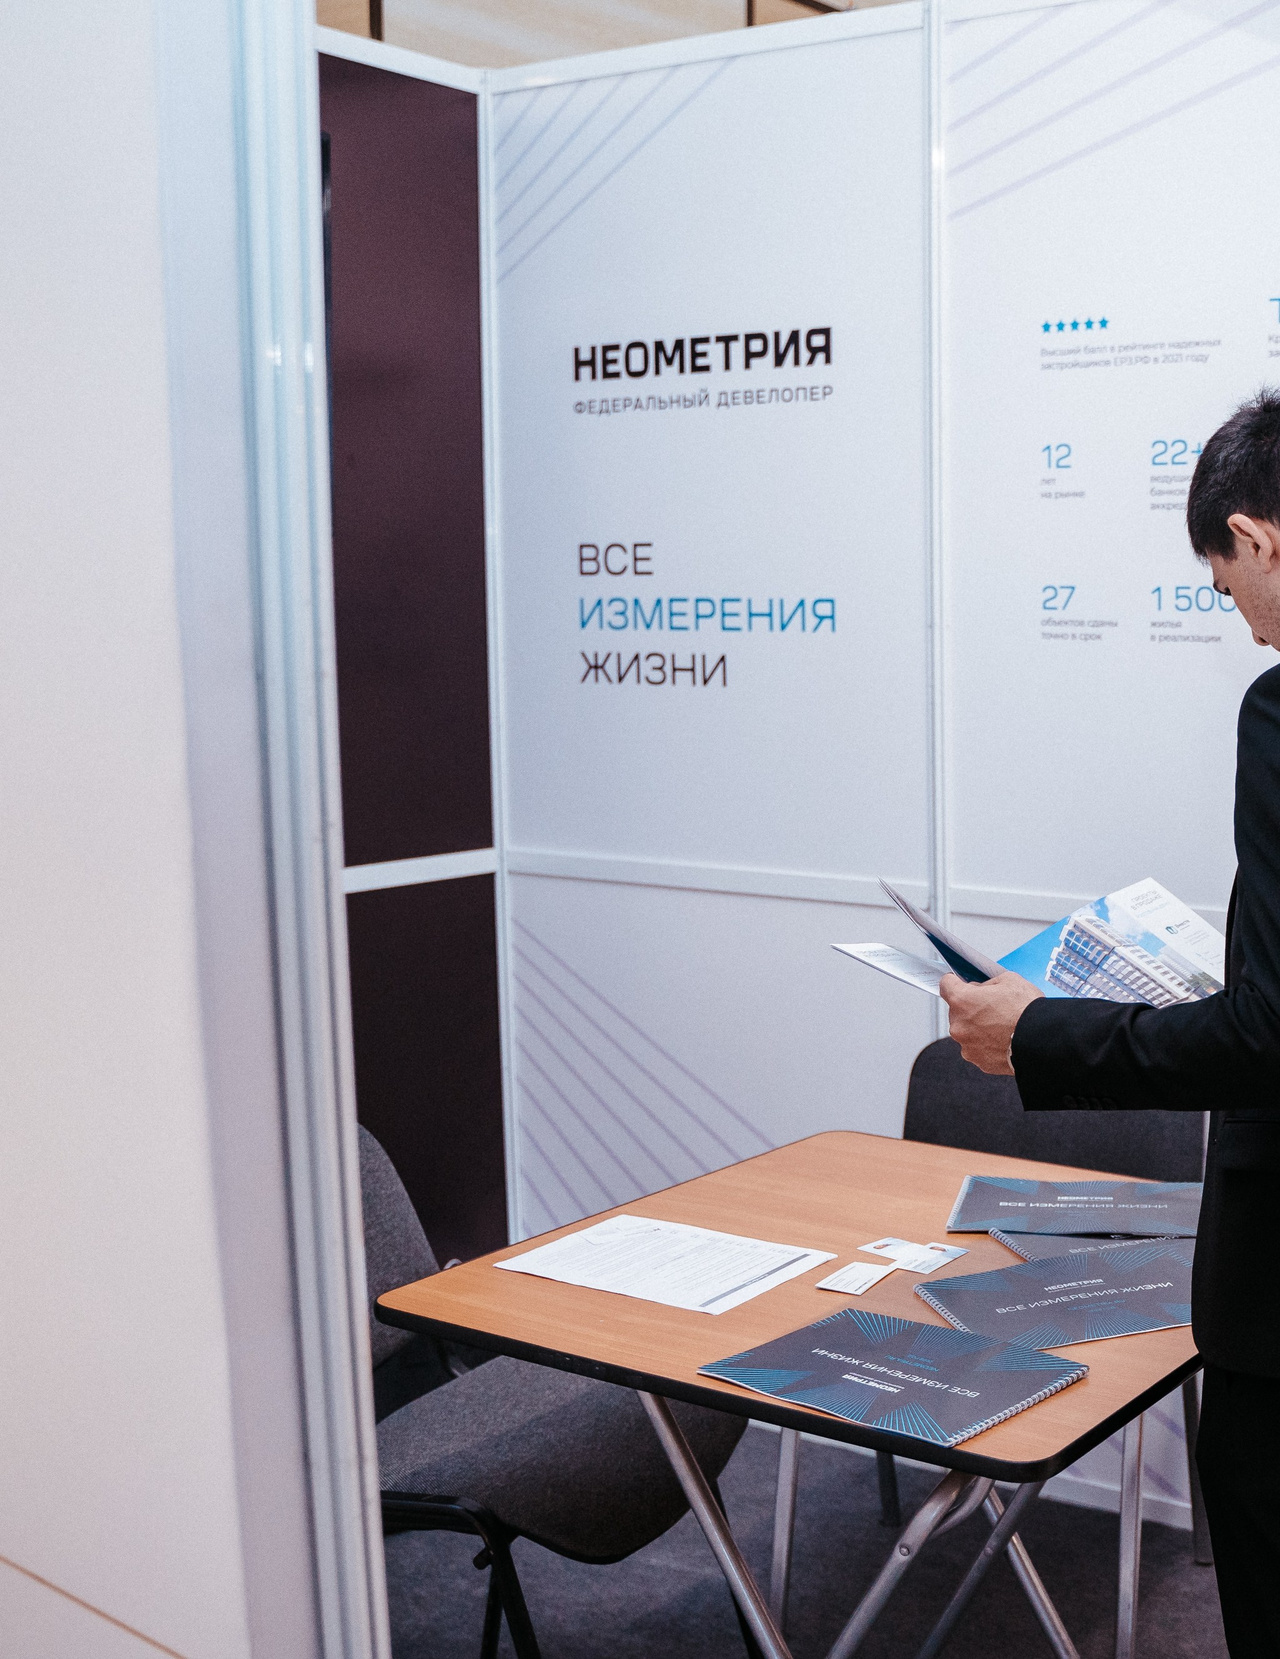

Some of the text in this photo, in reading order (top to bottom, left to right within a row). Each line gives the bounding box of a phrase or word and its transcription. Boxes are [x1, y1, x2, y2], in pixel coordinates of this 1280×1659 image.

[573, 326, 832, 382] НЕОМЕТРИЯ
[1040, 346, 1082, 357] Высший
[1084, 344, 1107, 355] балл
[1118, 342, 1166, 354] рейтинге
[1041, 358, 1111, 371] застройщиков
[1185, 353, 1210, 365] году
[573, 385, 833, 416] ФЕДЕРАЛЬНЫЙ ДЕВЕЛОПЕР
[1041, 443, 1072, 469] 12
[579, 543, 653, 576] ВСЕ
[1042, 585, 1076, 611] 27
[579, 597, 835, 633] ИЗМЕРЕНИЯ
[1041, 617, 1118, 629] объектов сданы
[1151, 621, 1182, 629] жилья
[1041, 632, 1069, 641] точно
[1079, 633, 1102, 643] срок
[1158, 634, 1221, 644] реализации
[581, 652, 727, 687] ЖИЗНИ
[1068, 1245, 1098, 1254] ВСЕ
[1044, 1278, 1104, 1292] НЕОМЕТРИЯ
[996, 1304, 1027, 1314] ВСЕ
[1028, 1288, 1119, 1309] ИЗМЕРЕНИЯ
[1119, 1281, 1174, 1294] ЖИЗНИ
[811, 1347, 863, 1366] ЖИЗНИ
[863, 1363, 950, 1390] ИЗМЕРЕНИЯ
[948, 1385, 980, 1398] ВСЕ
